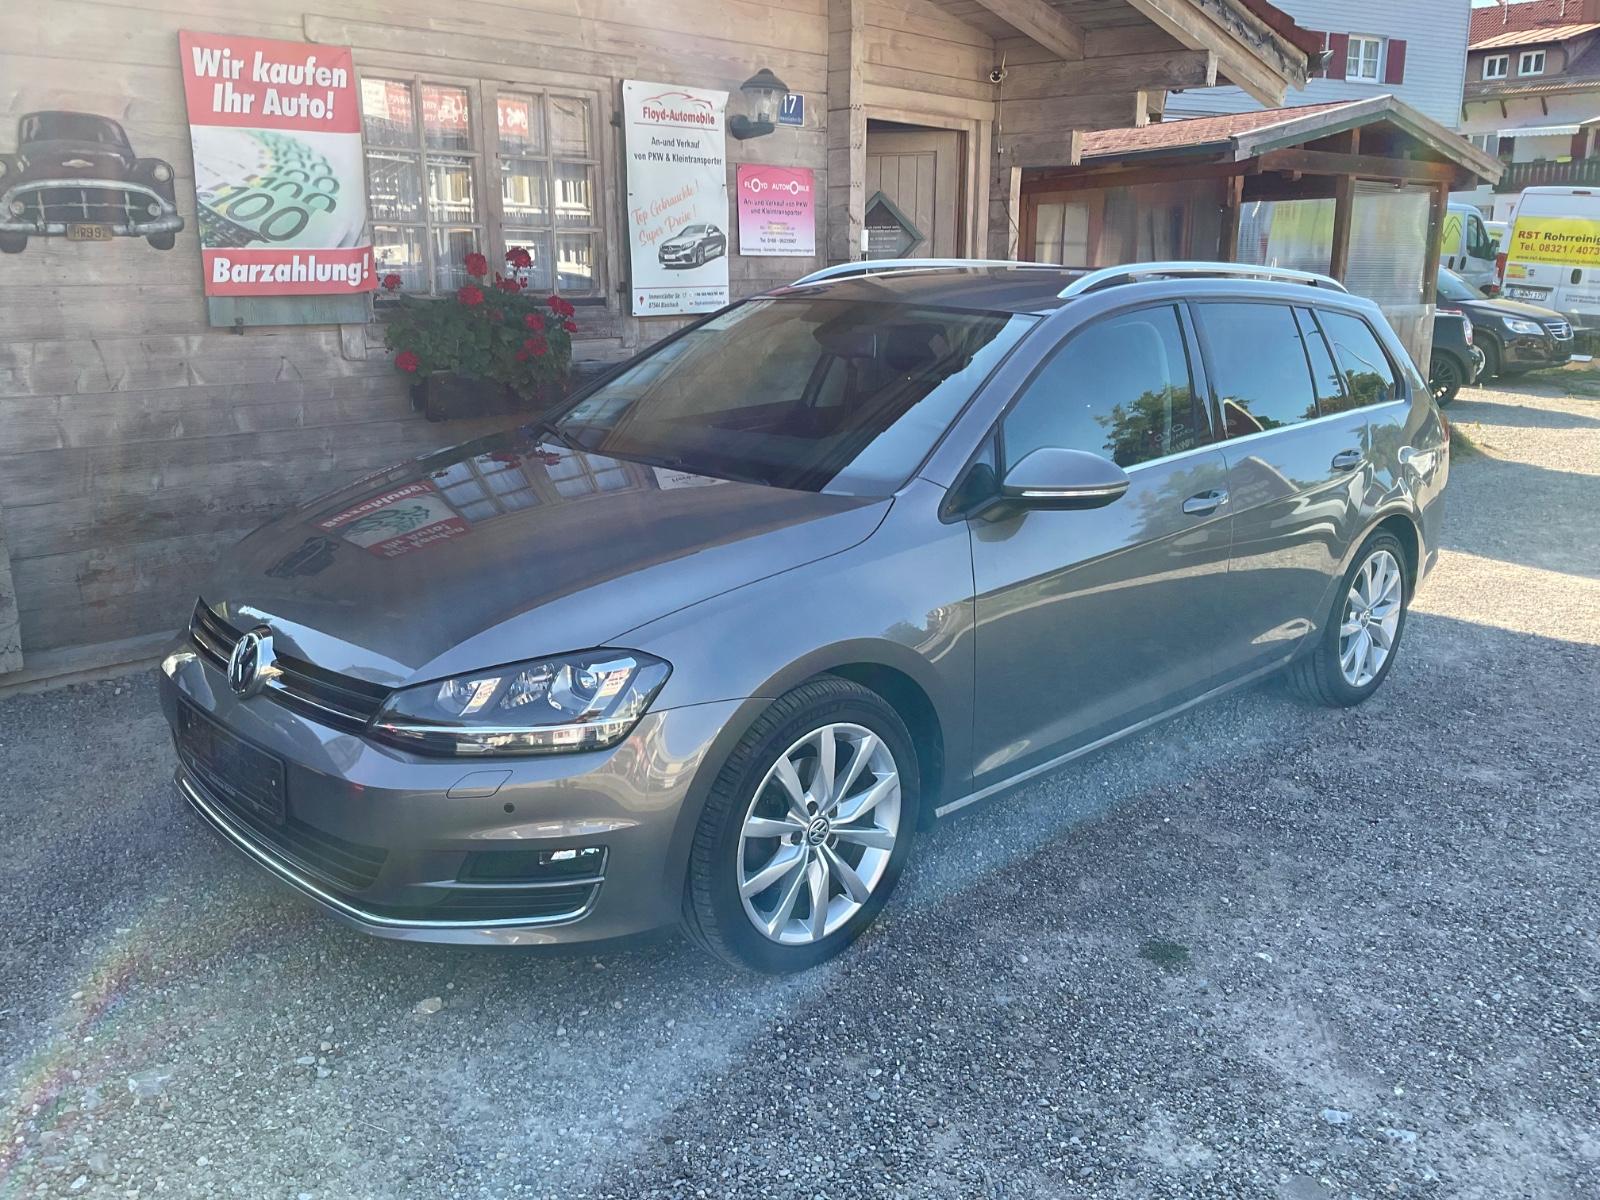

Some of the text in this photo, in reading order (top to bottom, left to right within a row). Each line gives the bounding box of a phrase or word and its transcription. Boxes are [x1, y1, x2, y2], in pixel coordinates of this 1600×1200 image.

[192, 47, 347, 89] Wir kaufen
[212, 83, 334, 119] Ihr Auto!
[784, 94, 797, 114] 17
[642, 106, 715, 125] Floyd-Automobile
[676, 139, 700, 148] Verkauf
[634, 152, 722, 166] von PKW & Kleintransporter
[744, 178, 810, 195] FLOYD AUTOMOBILE
[631, 207, 648, 225] Top
[1518, 230, 1542, 240] RST
[1520, 242, 1536, 251] Tel.
[1538, 244, 1568, 254] 08321
[1576, 246, 1600, 256] 4073
[212, 252, 369, 286] Barzahlung!
